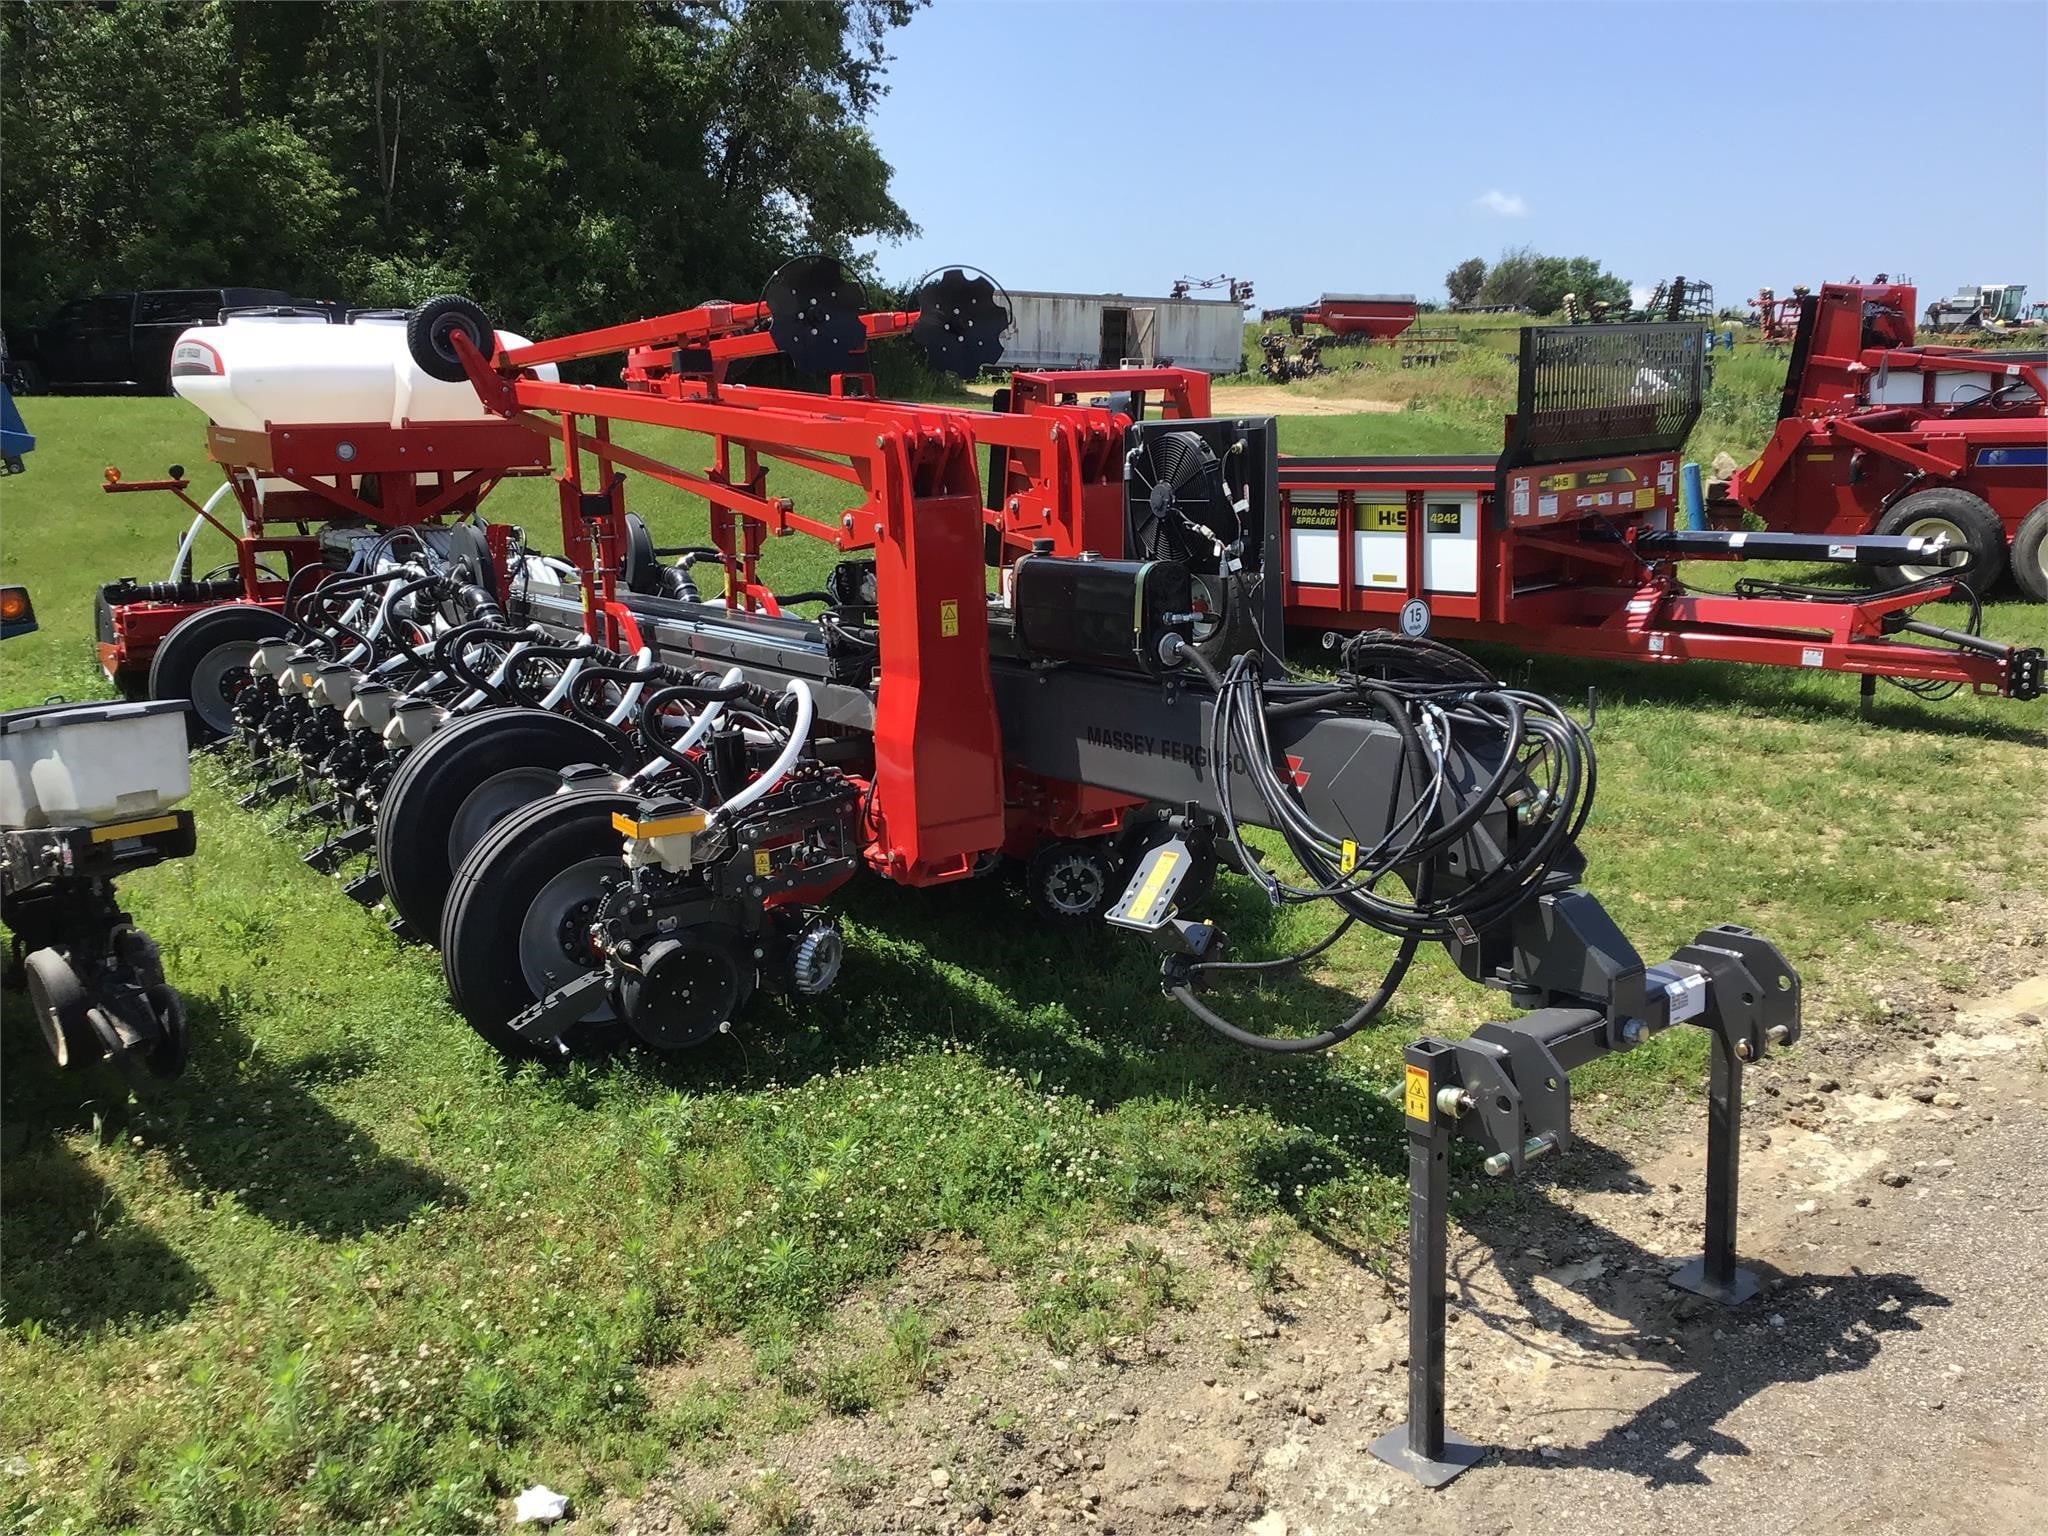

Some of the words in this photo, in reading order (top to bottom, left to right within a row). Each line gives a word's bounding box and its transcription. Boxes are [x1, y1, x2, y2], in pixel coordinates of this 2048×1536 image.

[1296, 516, 1337, 526] SPREADER
[1378, 510, 1407, 526] H&S
[1430, 512, 1459, 524] 4242
[1409, 608, 1422, 622] 15
[1086, 726, 1155, 756] MASSEY
